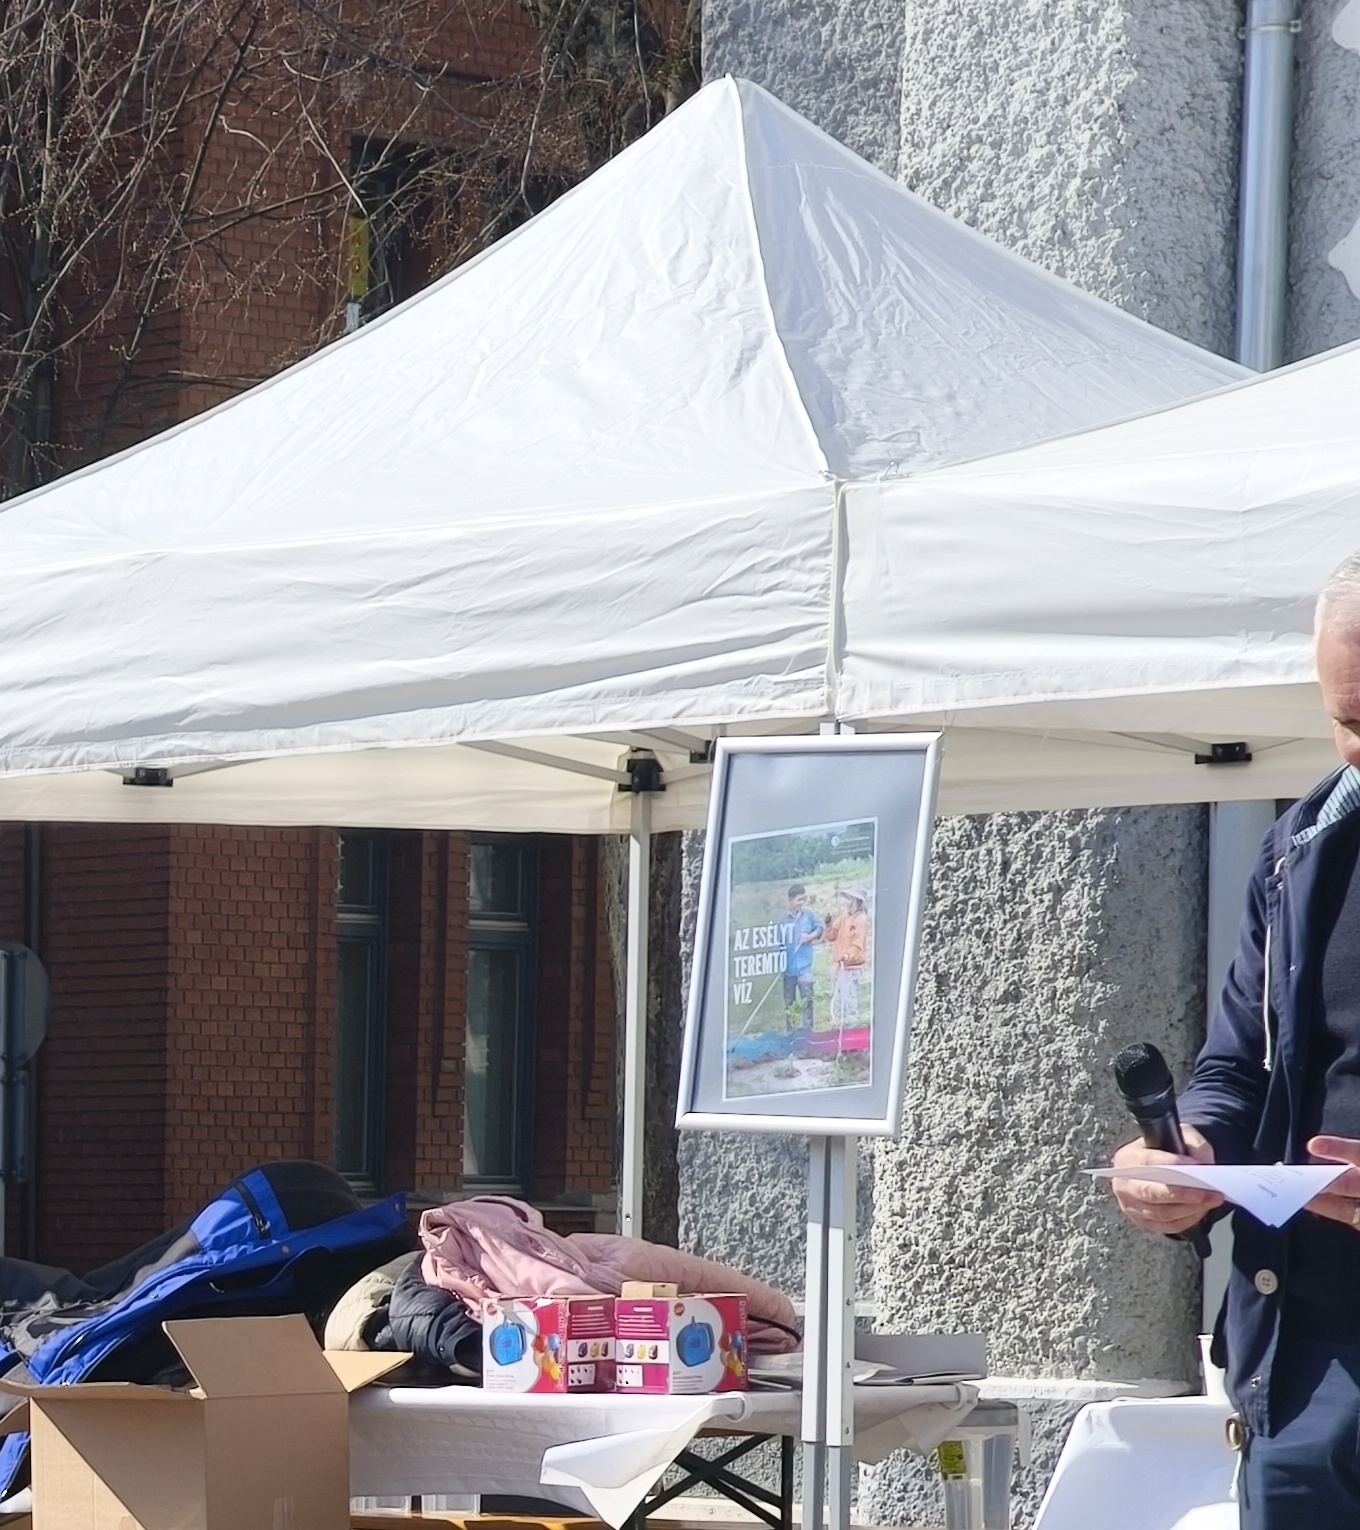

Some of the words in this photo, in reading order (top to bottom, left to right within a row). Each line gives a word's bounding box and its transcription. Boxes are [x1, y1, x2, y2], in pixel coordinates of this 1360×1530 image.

[733, 928, 750, 952] AZ
[752, 920, 795, 949] ESÉLYT
[733, 945, 788, 979] TEREMTŐ
[733, 977, 753, 1005] VÍZ
